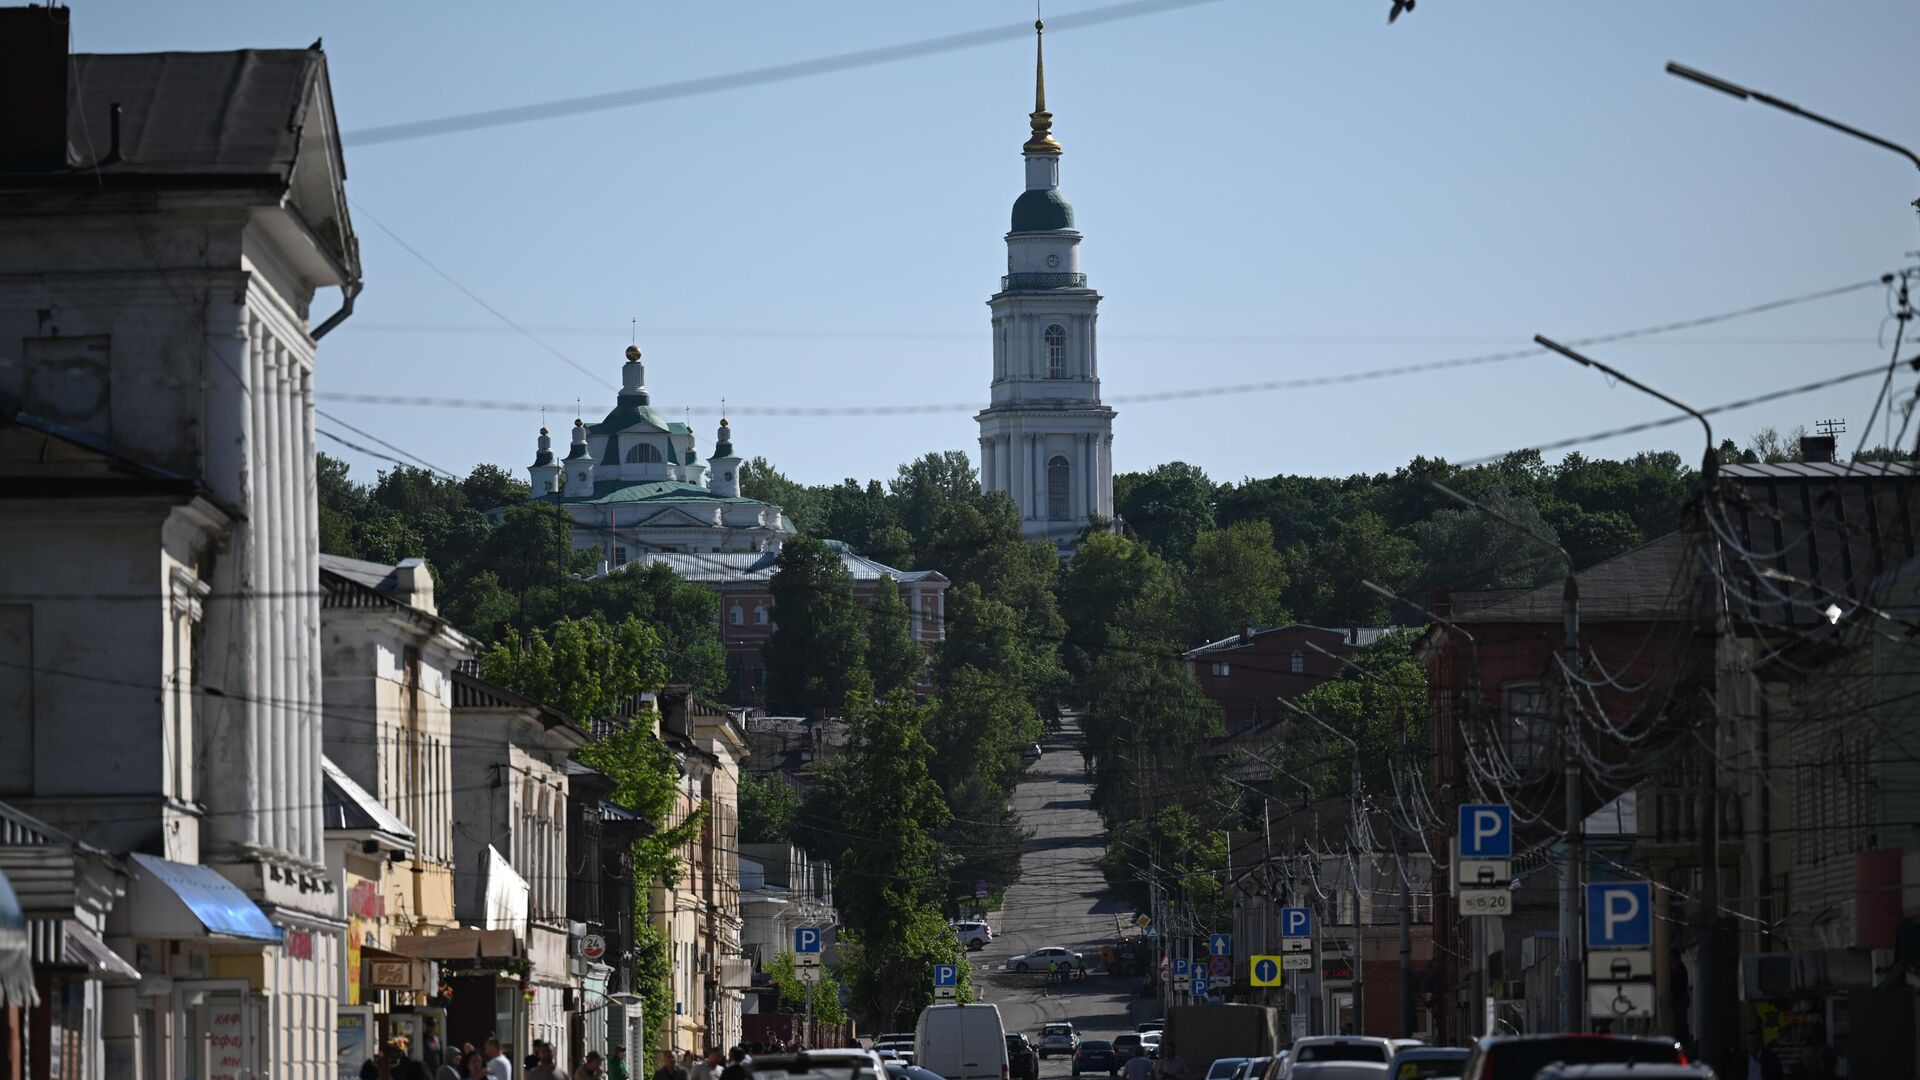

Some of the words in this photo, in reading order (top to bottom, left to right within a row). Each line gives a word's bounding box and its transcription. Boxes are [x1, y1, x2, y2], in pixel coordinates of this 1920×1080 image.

[1473, 810, 1503, 851] P
[1490, 896, 1505, 907] 20
[1604, 889, 1639, 940] P
[1289, 911, 1306, 934] P
[587, 939, 599, 948] 24
[802, 930, 816, 951] P
[1177, 960, 1186, 973] P
[941, 967, 953, 984] P
[1195, 981, 1205, 994] P
[214, 1013, 241, 1025] КАФ
